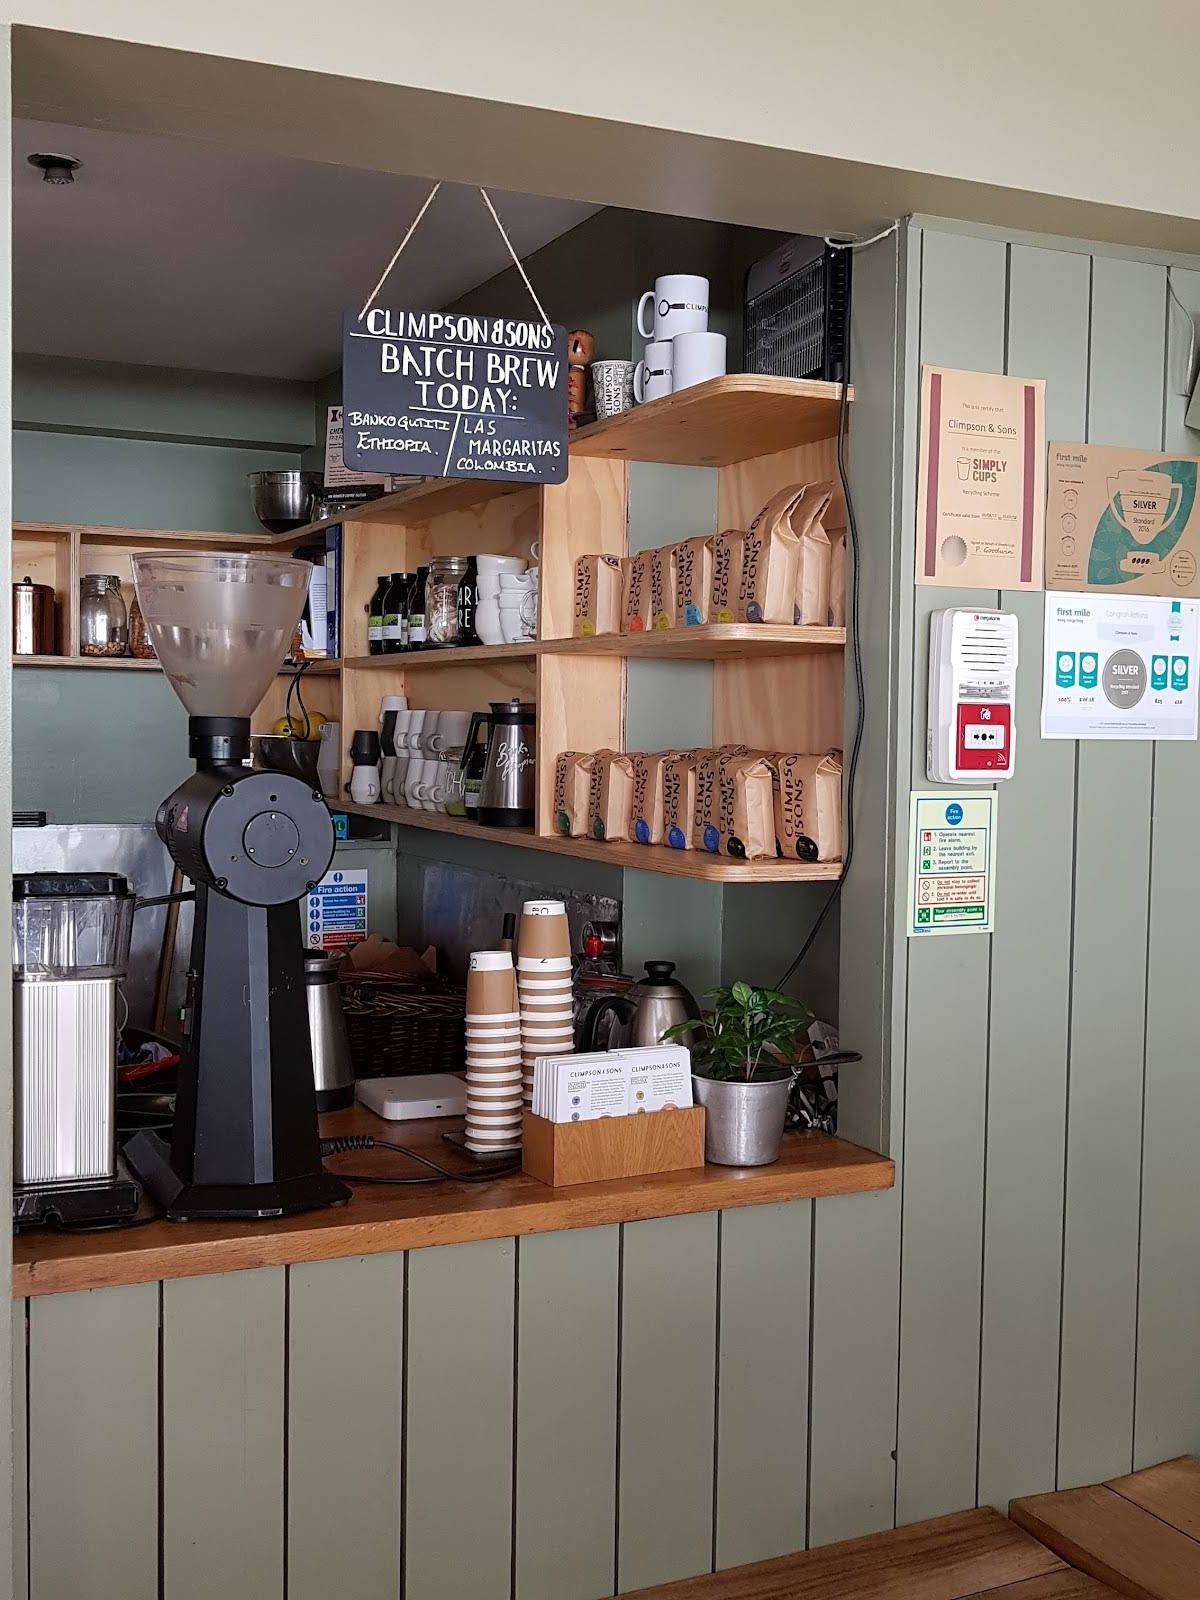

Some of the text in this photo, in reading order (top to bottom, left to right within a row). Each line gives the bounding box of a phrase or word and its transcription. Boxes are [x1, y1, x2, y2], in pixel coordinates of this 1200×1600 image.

[381, 343, 560, 389] BATCH BREW
[415, 381, 518, 414] TODAY:
[348, 411, 396, 427] BANKO
[463, 419, 497, 435] LAS
[948, 419, 1017, 435] Climpson & Sons
[468, 439, 561, 457] MARGARITAS
[1056, 453, 1071, 461] first
[972, 458, 1007, 473] SIMPLY
[972, 471, 997, 483] CUPS
[1133, 500, 1157, 510] SILVER
[1133, 517, 1155, 525] Standard
[1138, 525, 1150, 533] 2016
[1056, 607, 1091, 617] first mile
[1112, 665, 1139, 675] SILVER
